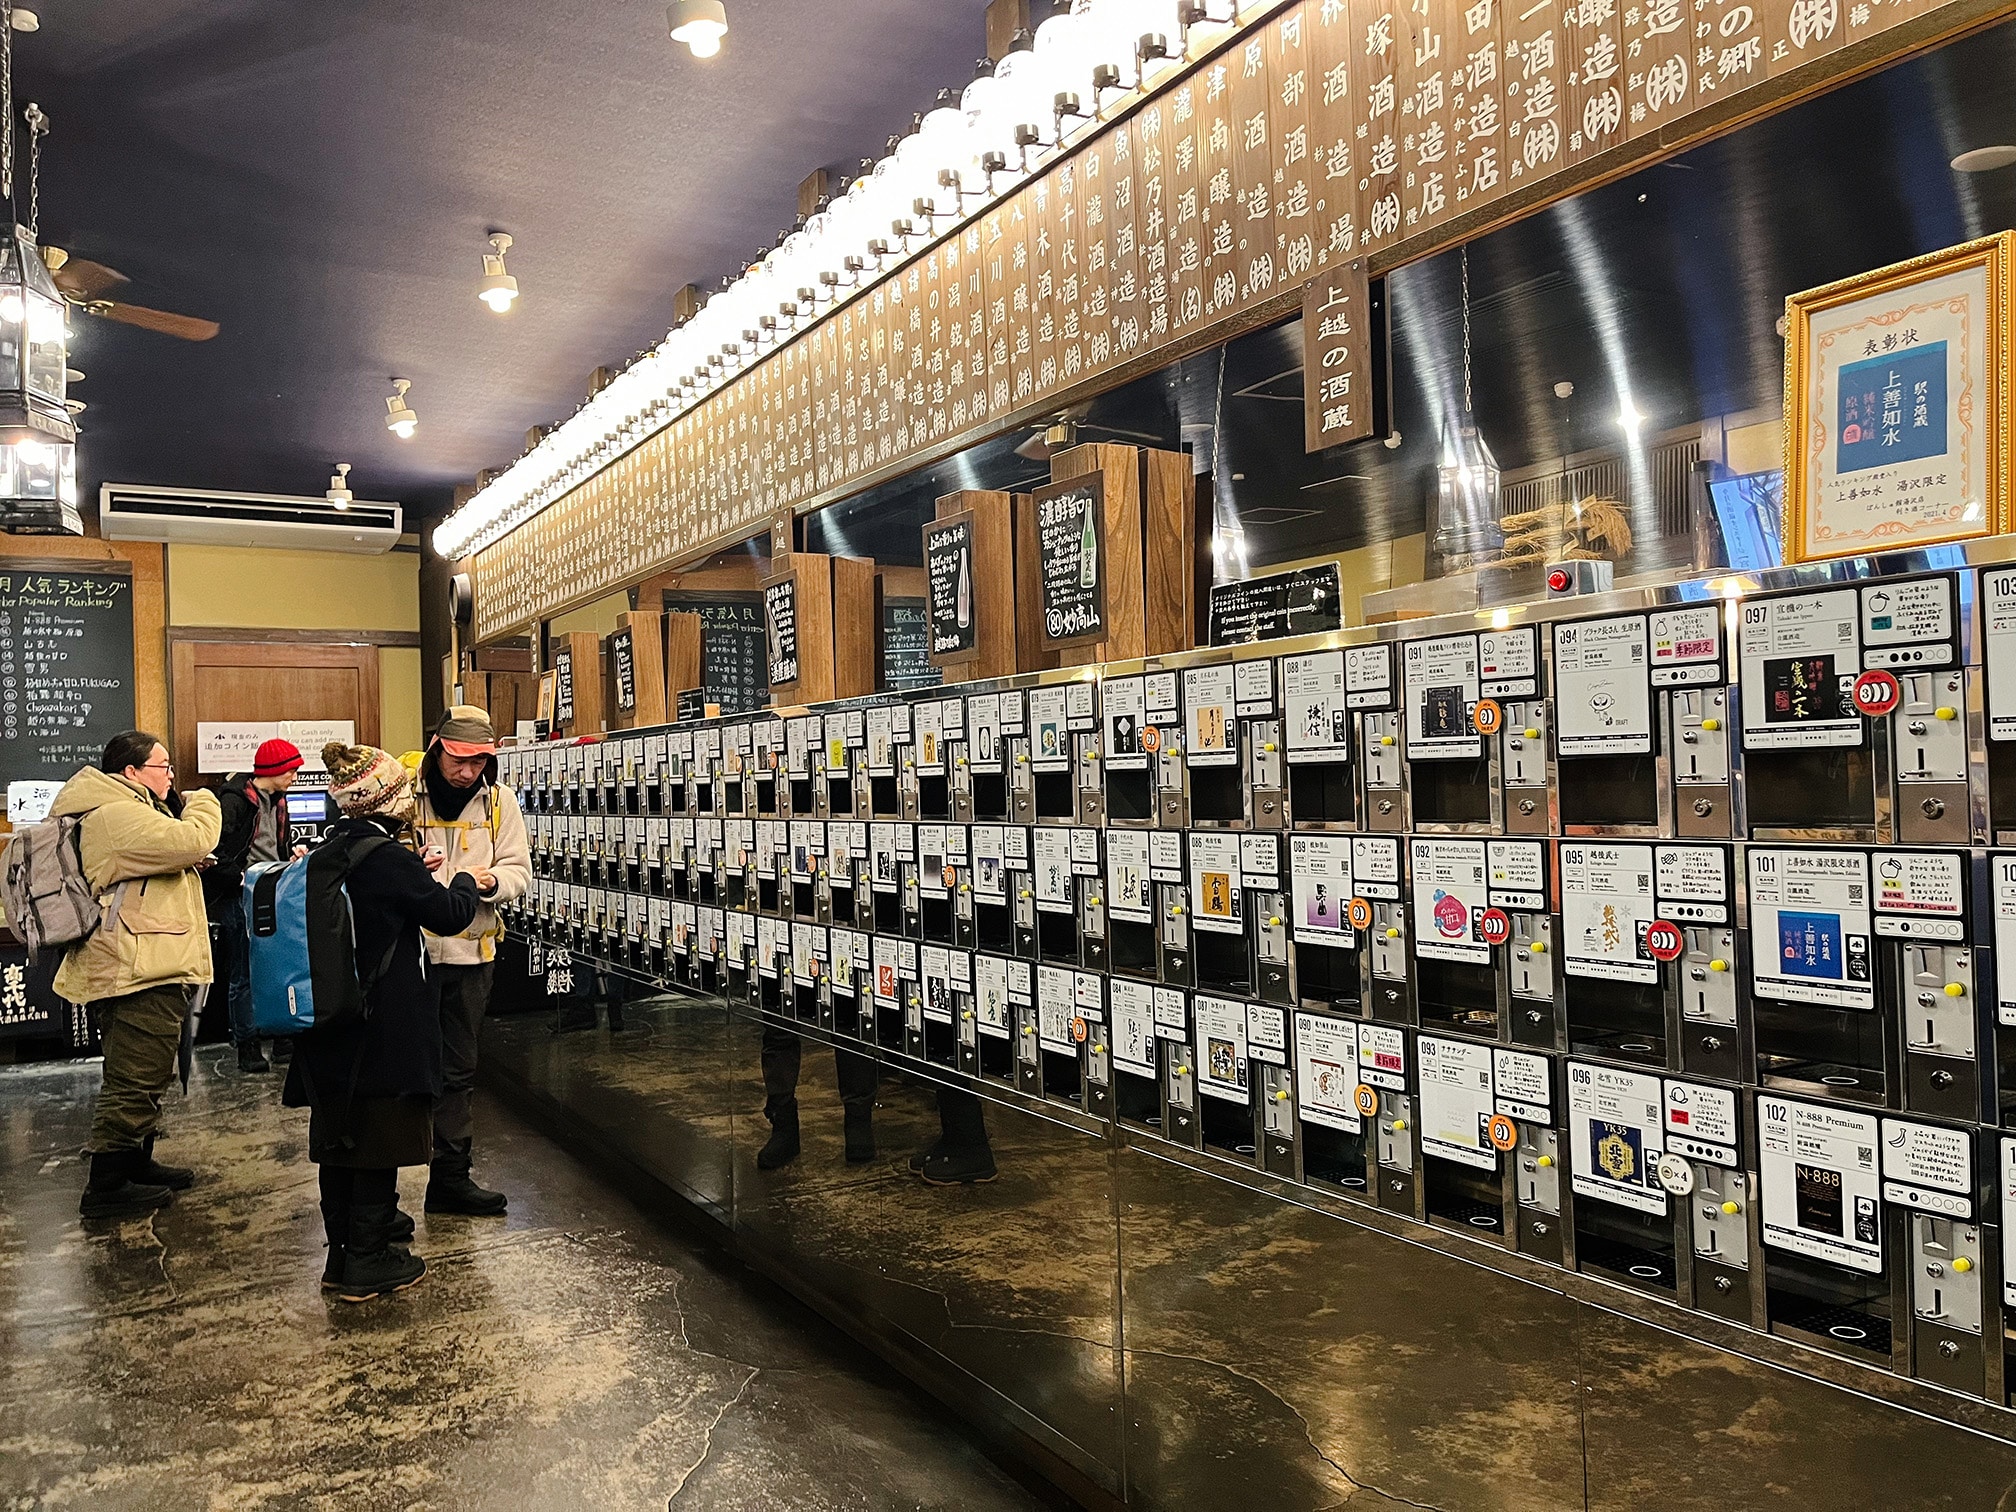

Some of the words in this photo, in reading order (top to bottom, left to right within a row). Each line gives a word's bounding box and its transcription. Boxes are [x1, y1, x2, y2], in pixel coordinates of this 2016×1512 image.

[1717, 0, 1761, 82] の郷
[1465, 0, 1501, 195] 田酒造店
[1450, 69, 1469, 202] 越乃かたふね
[1862, 329, 1919, 356] 表彰状
[1316, 286, 1354, 433] 上越の酒蔵
[1881, 370, 1902, 447] 上善如水
[1836, 484, 1883, 503] 上善如水
[1896, 473, 1948, 492] 湯沢限定
[1040, 495, 1085, 527] 濃醇旨口
[20, 576, 52, 594] 人気
[57, 579, 127, 597] ランキング
[19, 595, 60, 607] Popular
[65, 597, 113, 608] Ranking
[1064, 604, 1100, 634] 妙高山
[1746, 607, 1767, 624] 097
[1560, 629, 1577, 644] 094
[1409, 647, 1422, 660] 091
[1676, 641, 1712, 657] 季節限定
[1862, 688, 1869, 698] 3
[319, 729, 334, 737] only
[1415, 845, 1430, 858] 092
[1565, 850, 1583, 865] 095
[1590, 851, 1620, 860] 越後武士
[1756, 856, 1775, 872] 101
[1804, 922, 1817, 966] 上善如水
[1421, 1041, 1435, 1055] 093
[1573, 1068, 1590, 1085] 096
[1597, 1073, 1611, 1084] 北雪
[1614, 1076, 1633, 1087] YK35
[1765, 1104, 1786, 1122] 102
[1796, 1110, 1823, 1122] N-888
[1826, 1115, 1864, 1130] Premium
[1603, 1122, 1628, 1135] YK35
[1797, 1165, 1840, 1187] N-888
